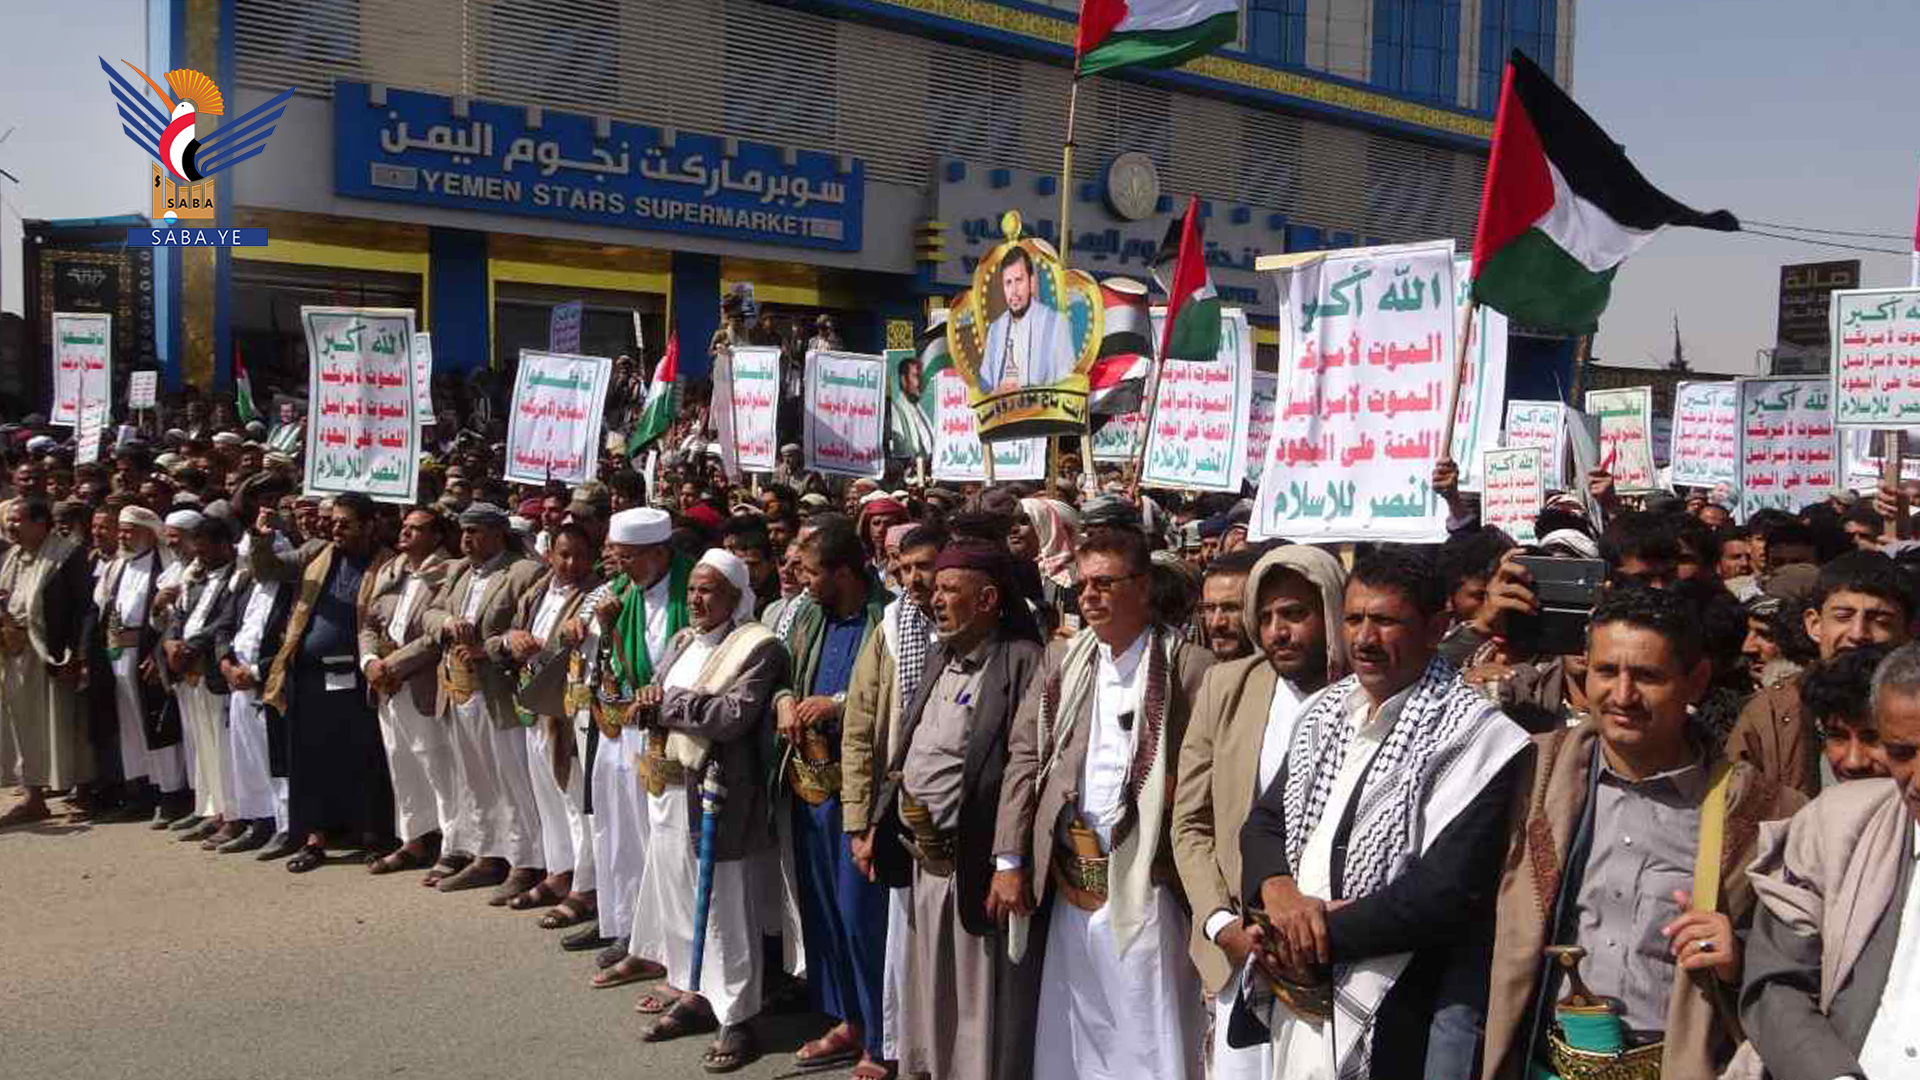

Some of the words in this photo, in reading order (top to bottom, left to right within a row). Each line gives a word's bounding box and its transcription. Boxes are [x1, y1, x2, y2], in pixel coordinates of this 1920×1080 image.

[380, 111, 493, 165] اليمن
[504, 141, 629, 179] نجوم
[641, 146, 845, 208] سوبرماركت
[422, 168, 521, 200] YEMEN
[533, 184, 626, 214] STARS
[636, 198, 813, 236] SUPERMARKET
[1378, 264, 1442, 312] الله
[1843, 295, 1903, 328] أكبر
[321, 319, 367, 360] أكبر
[372, 327, 406, 355] الله
[1298, 331, 1360, 375] لأمريك
[1368, 332, 1442, 370] الموت
[1368, 381, 1442, 418] الموت
[1748, 383, 1802, 418] أكبر
[1841, 374, 1877, 393] اليهود
[1841, 396, 1890, 420] للإسلام
[1276, 433, 1334, 467] اليهود
[1341, 432, 1374, 467] على
[1384, 430, 1440, 459] اللعنة
[317, 454, 362, 487] للإسلام
[365, 456, 406, 487] النصر
[1273, 480, 1356, 530] للإسلام
[1362, 475, 1438, 530] النصر
